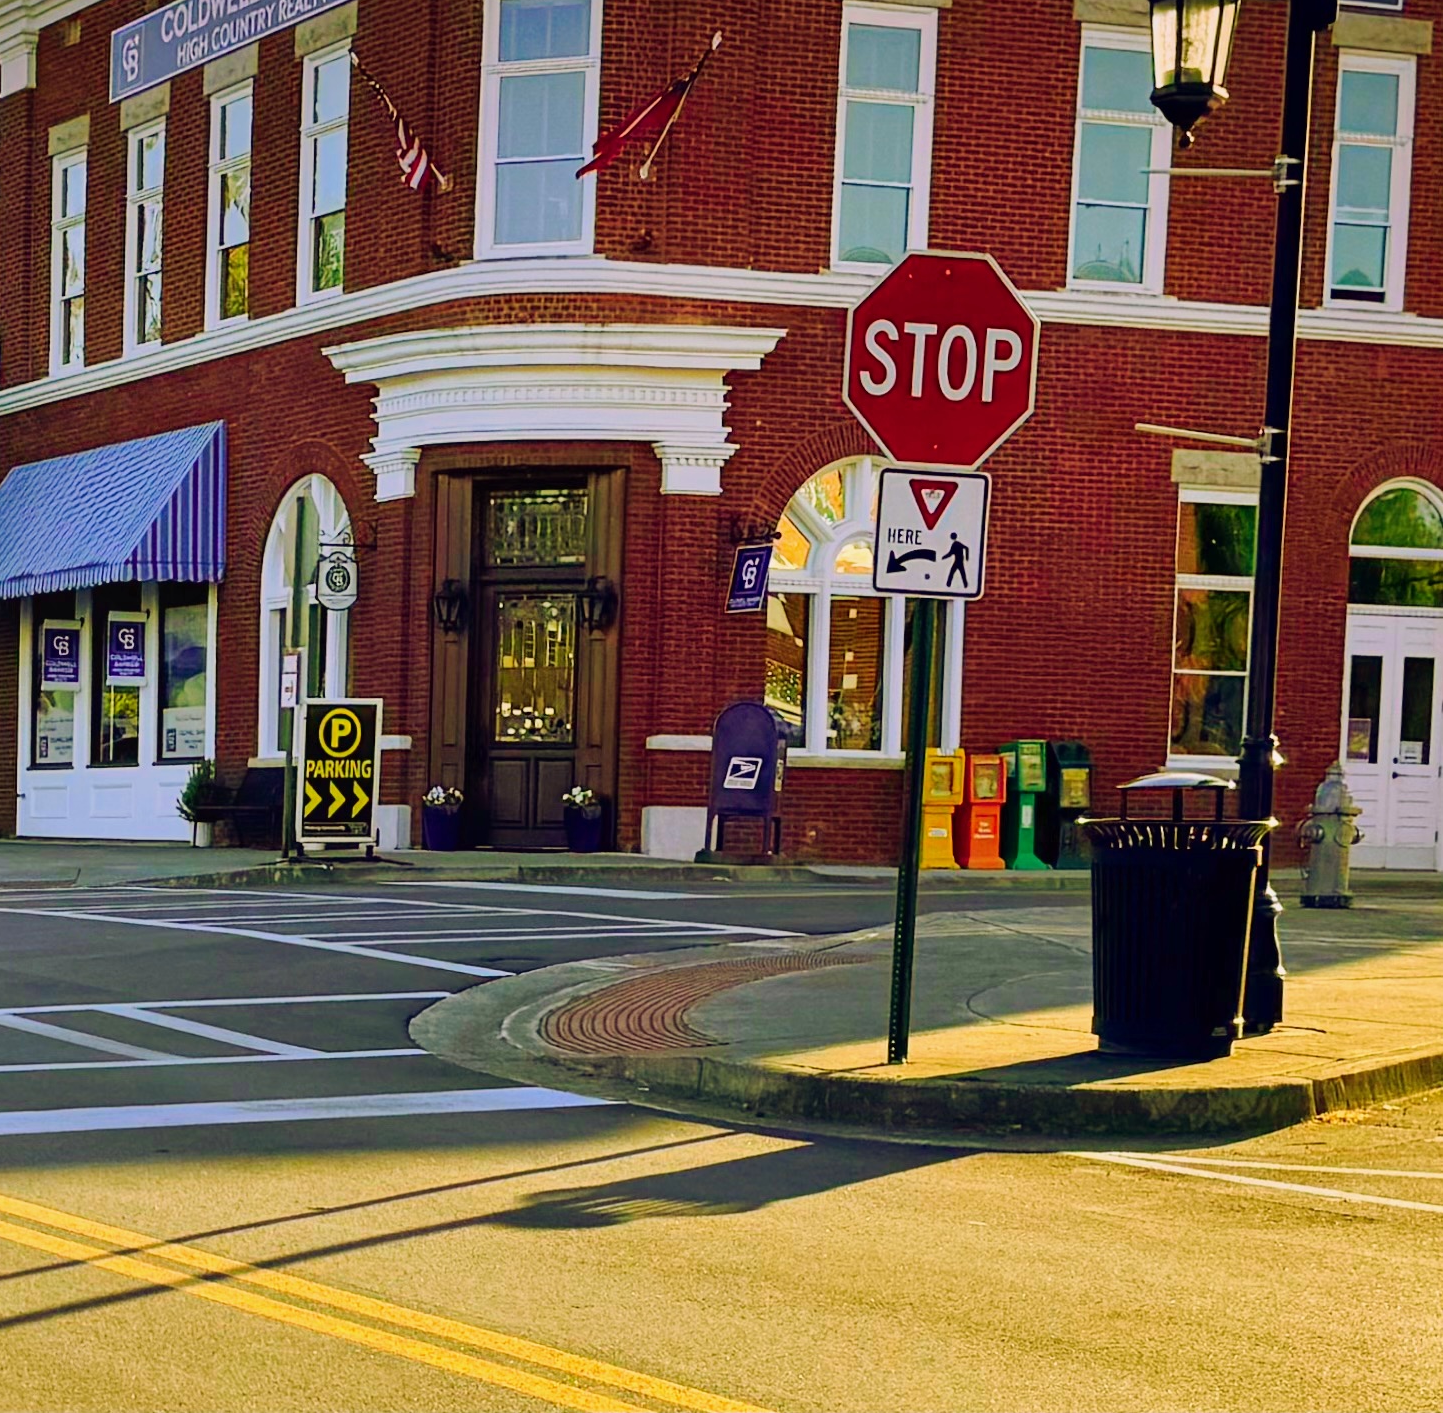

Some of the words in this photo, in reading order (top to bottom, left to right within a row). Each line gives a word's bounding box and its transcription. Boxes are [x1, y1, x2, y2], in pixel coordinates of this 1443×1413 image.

[177, 37, 209, 68] HIGH
[212, 2, 275, 49] COUNTRY
[859, 318, 1023, 403] STOP
[887, 527, 923, 546] HERE
[330, 718, 352, 748] P
[306, 759, 372, 778] PARKING
